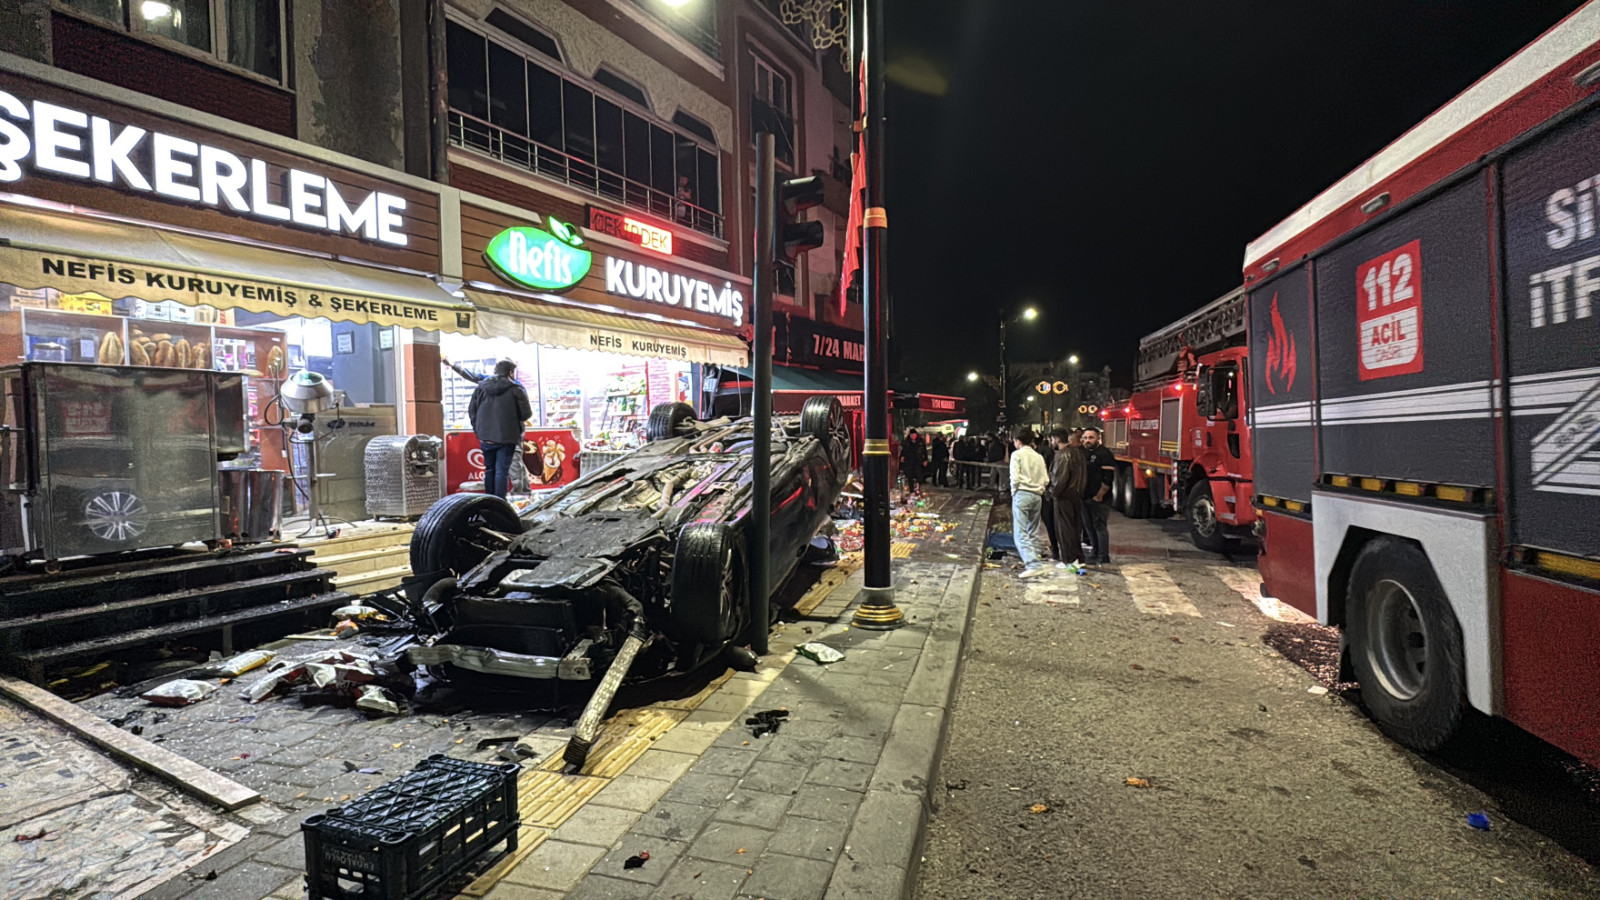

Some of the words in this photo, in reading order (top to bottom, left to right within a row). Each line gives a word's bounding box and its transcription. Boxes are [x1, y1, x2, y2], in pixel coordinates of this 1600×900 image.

[0, 90, 408, 247] ŞEKERLEME
[1545, 173, 1600, 249] Sİ
[42, 257, 136, 285] NEFİS
[146, 272, 297, 307] KURUYEMİŞ
[308, 294, 323, 307] &
[330, 296, 438, 321] ŞEKERLEME
[605, 256, 744, 327] KURUYEMİŞ
[1363, 253, 1414, 311] 112
[590, 334, 622, 349] NEFİS
[632, 340, 687, 359] KURUYEMİŞ
[812, 334, 840, 358] 7/24
[1370, 315, 1406, 347] ACİL
